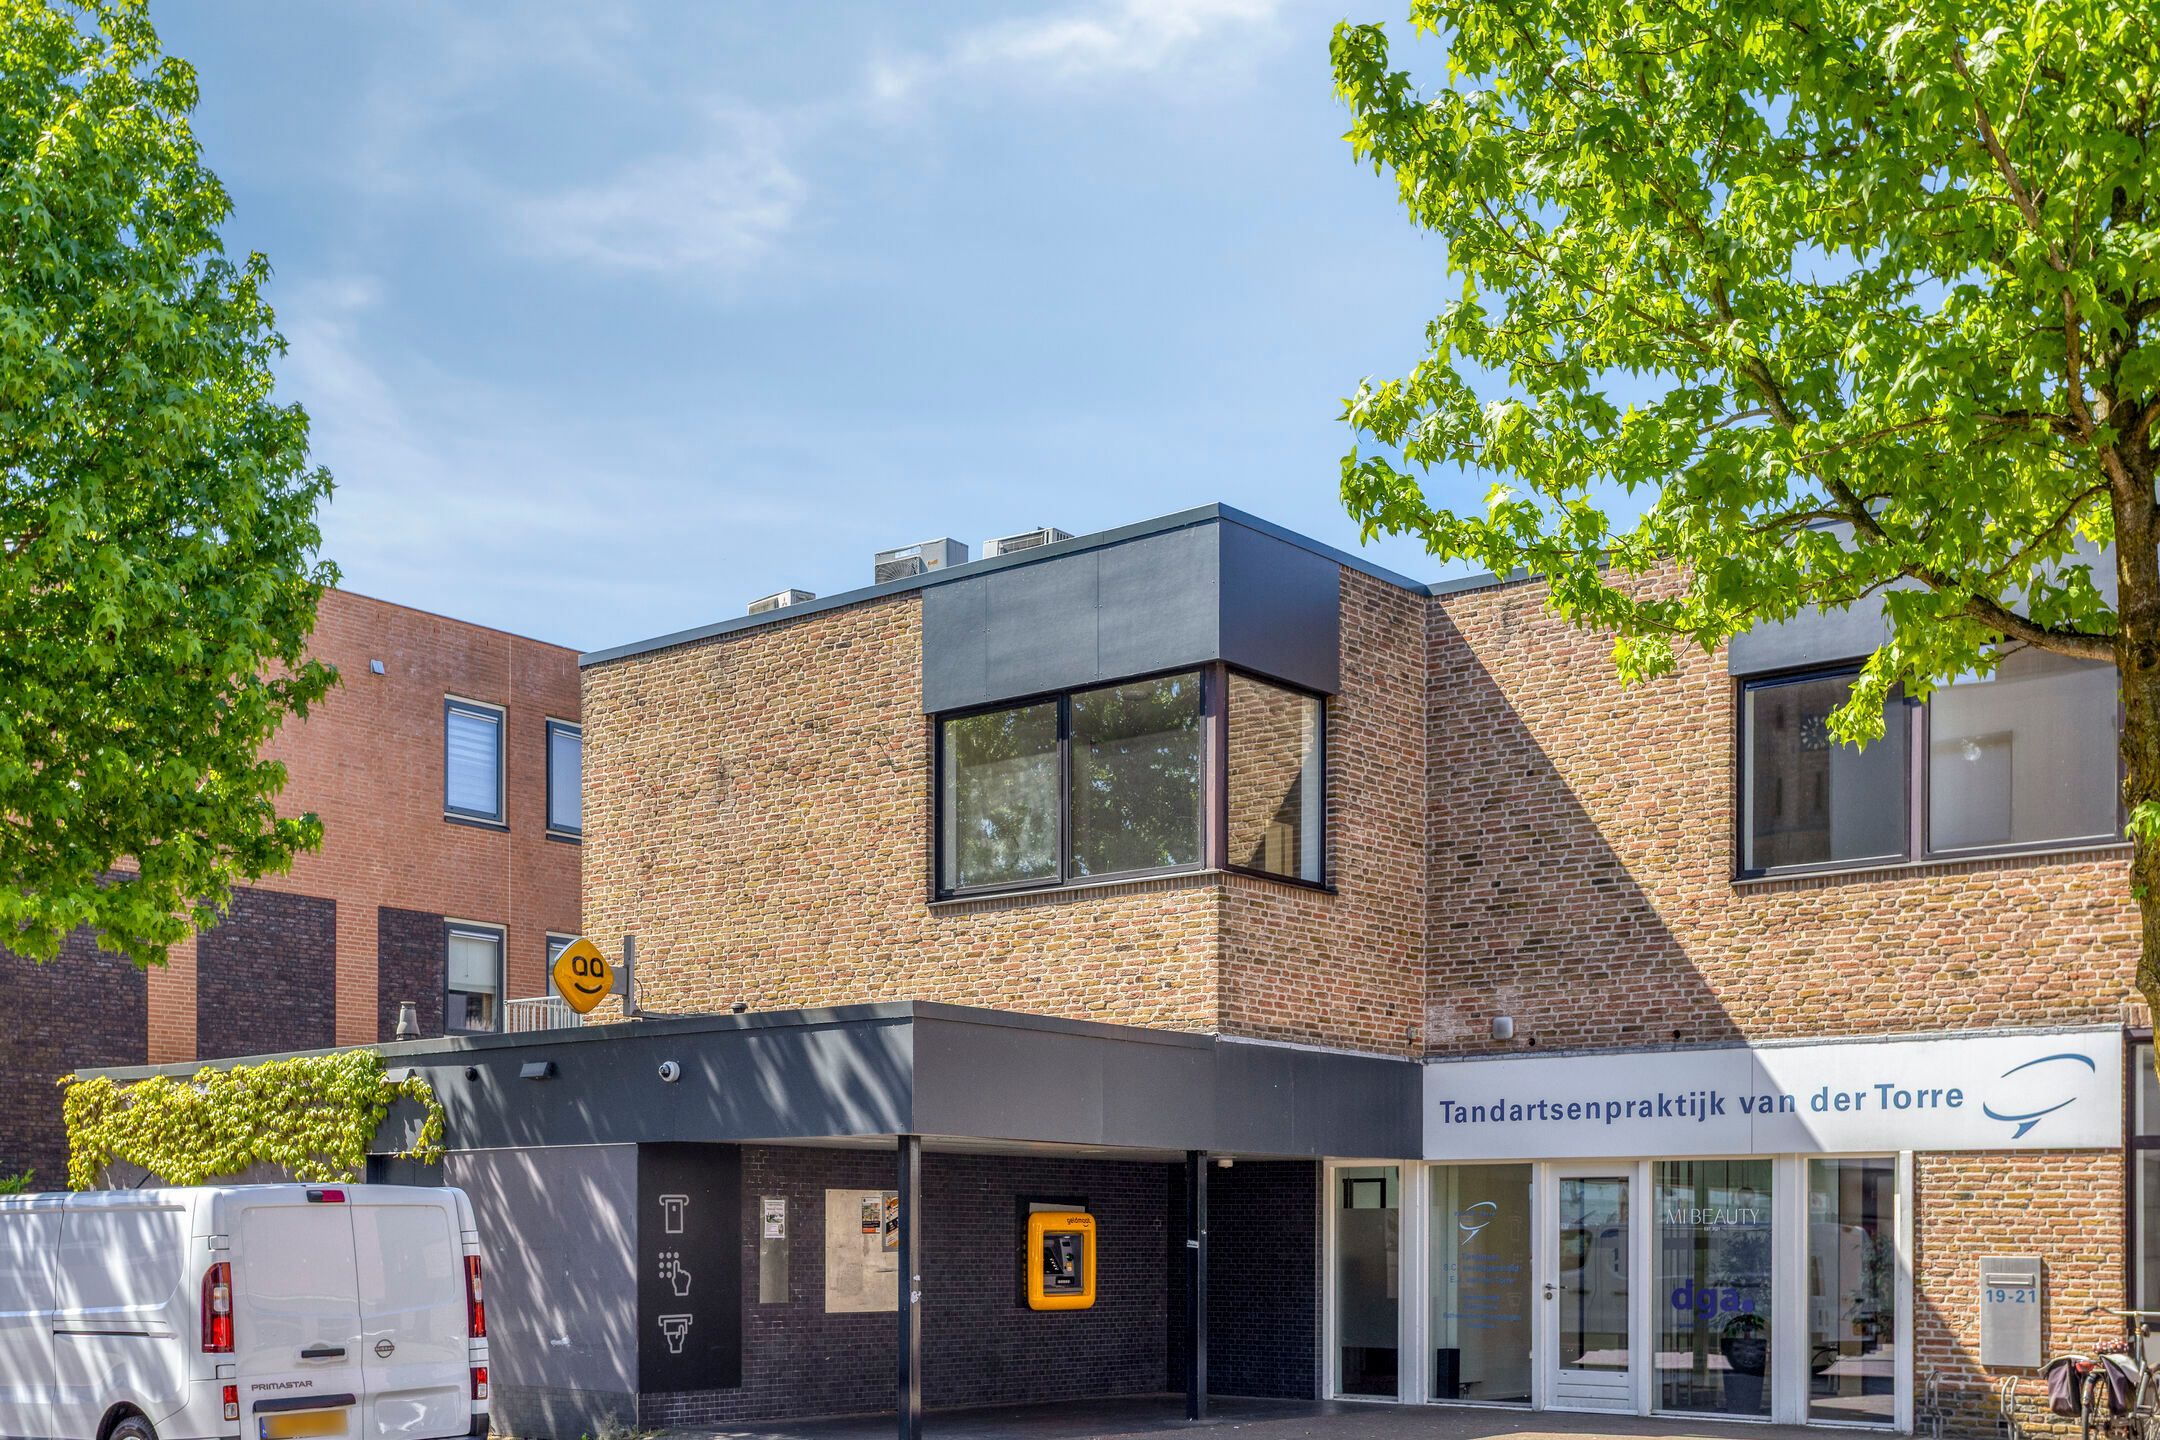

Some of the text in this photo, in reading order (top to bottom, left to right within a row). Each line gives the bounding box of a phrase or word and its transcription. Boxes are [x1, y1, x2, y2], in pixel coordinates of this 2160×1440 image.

[1439, 1083, 1964, 1124] Tandartsenpraktijk van der Torre
[1665, 1207, 1760, 1225] MI BEAUTY
[1985, 1289, 2036, 1304] 19-21
[251, 1380, 313, 1392] PRIMASTAR
